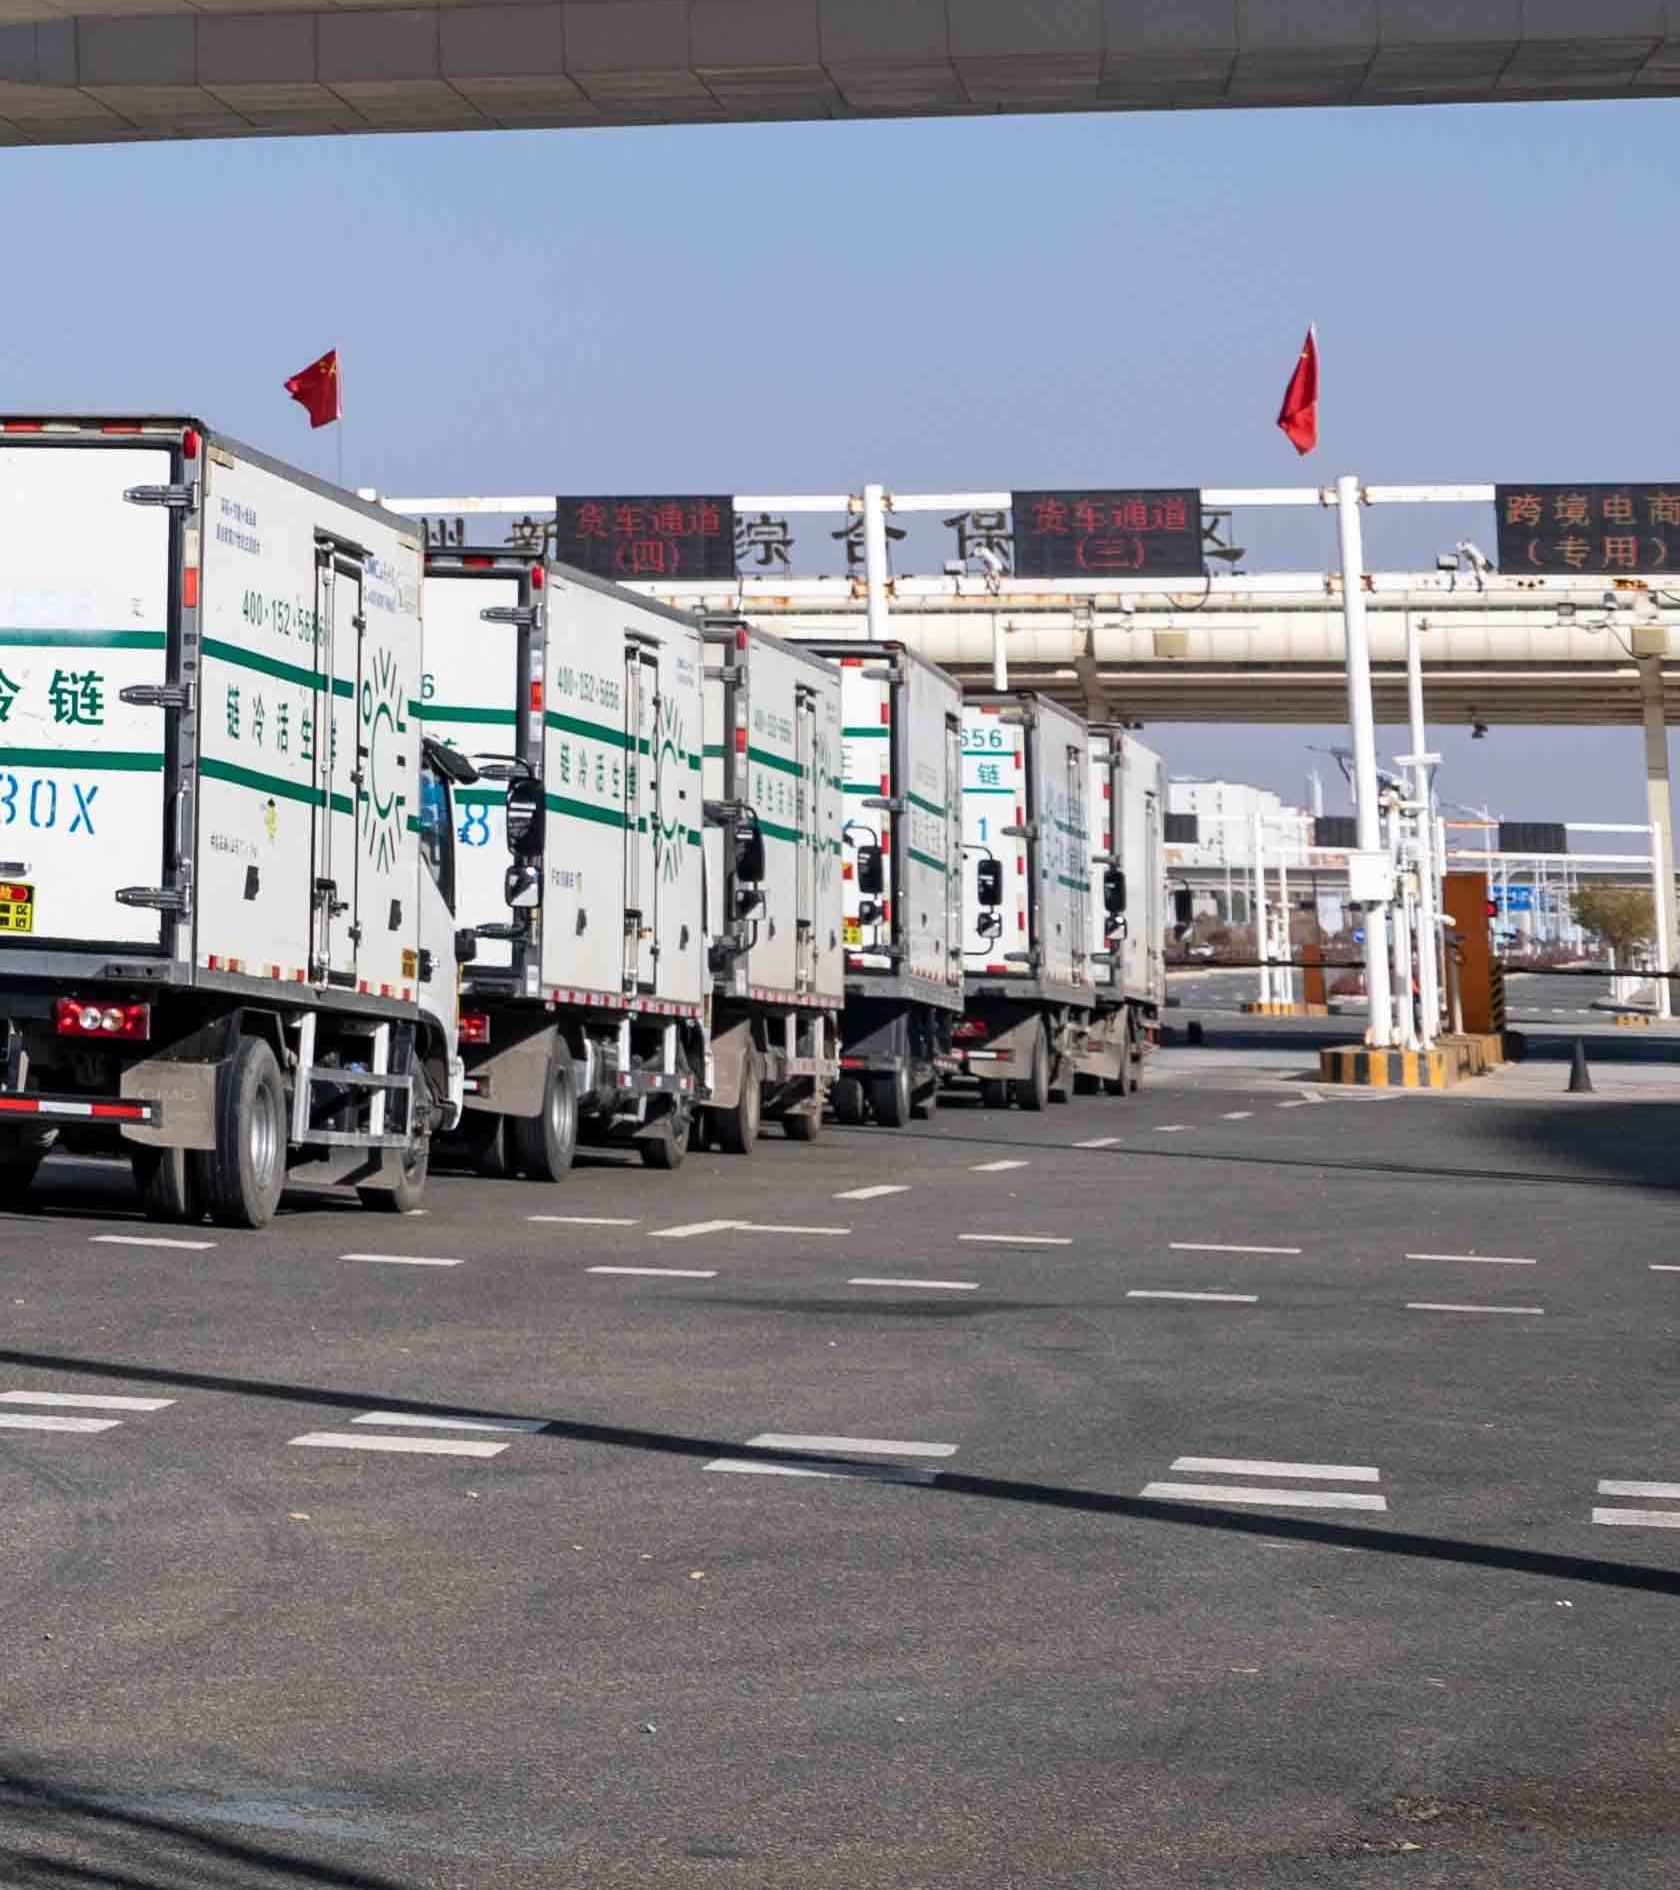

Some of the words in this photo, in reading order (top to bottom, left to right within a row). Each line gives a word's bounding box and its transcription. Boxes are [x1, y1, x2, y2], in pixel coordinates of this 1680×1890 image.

[575, 501, 722, 541] 货车通道
[1034, 497, 1188, 535] 货车通道
[1505, 493, 1680, 526] 跨境电商
